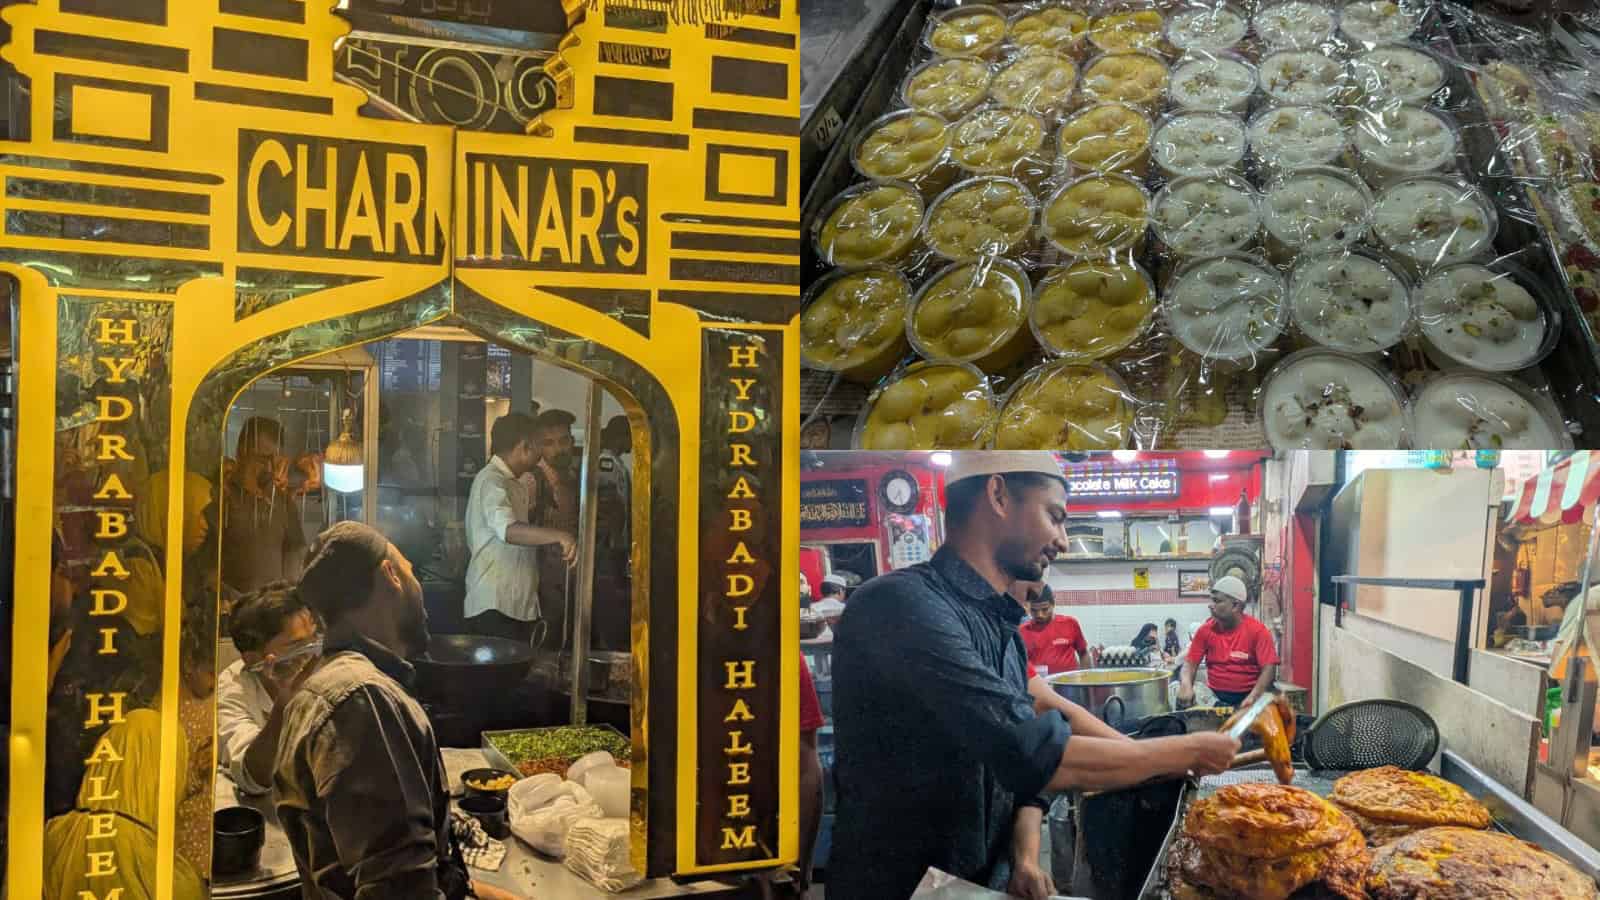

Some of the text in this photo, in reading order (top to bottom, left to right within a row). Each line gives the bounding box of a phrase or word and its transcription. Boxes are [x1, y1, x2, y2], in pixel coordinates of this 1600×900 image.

[89, 318, 137, 655] HYDRABADI
[719, 345, 758, 849] HYDRABADI HALEEM
[1114, 477, 1138, 490] Milk
[1139, 476, 1171, 489] Cake
